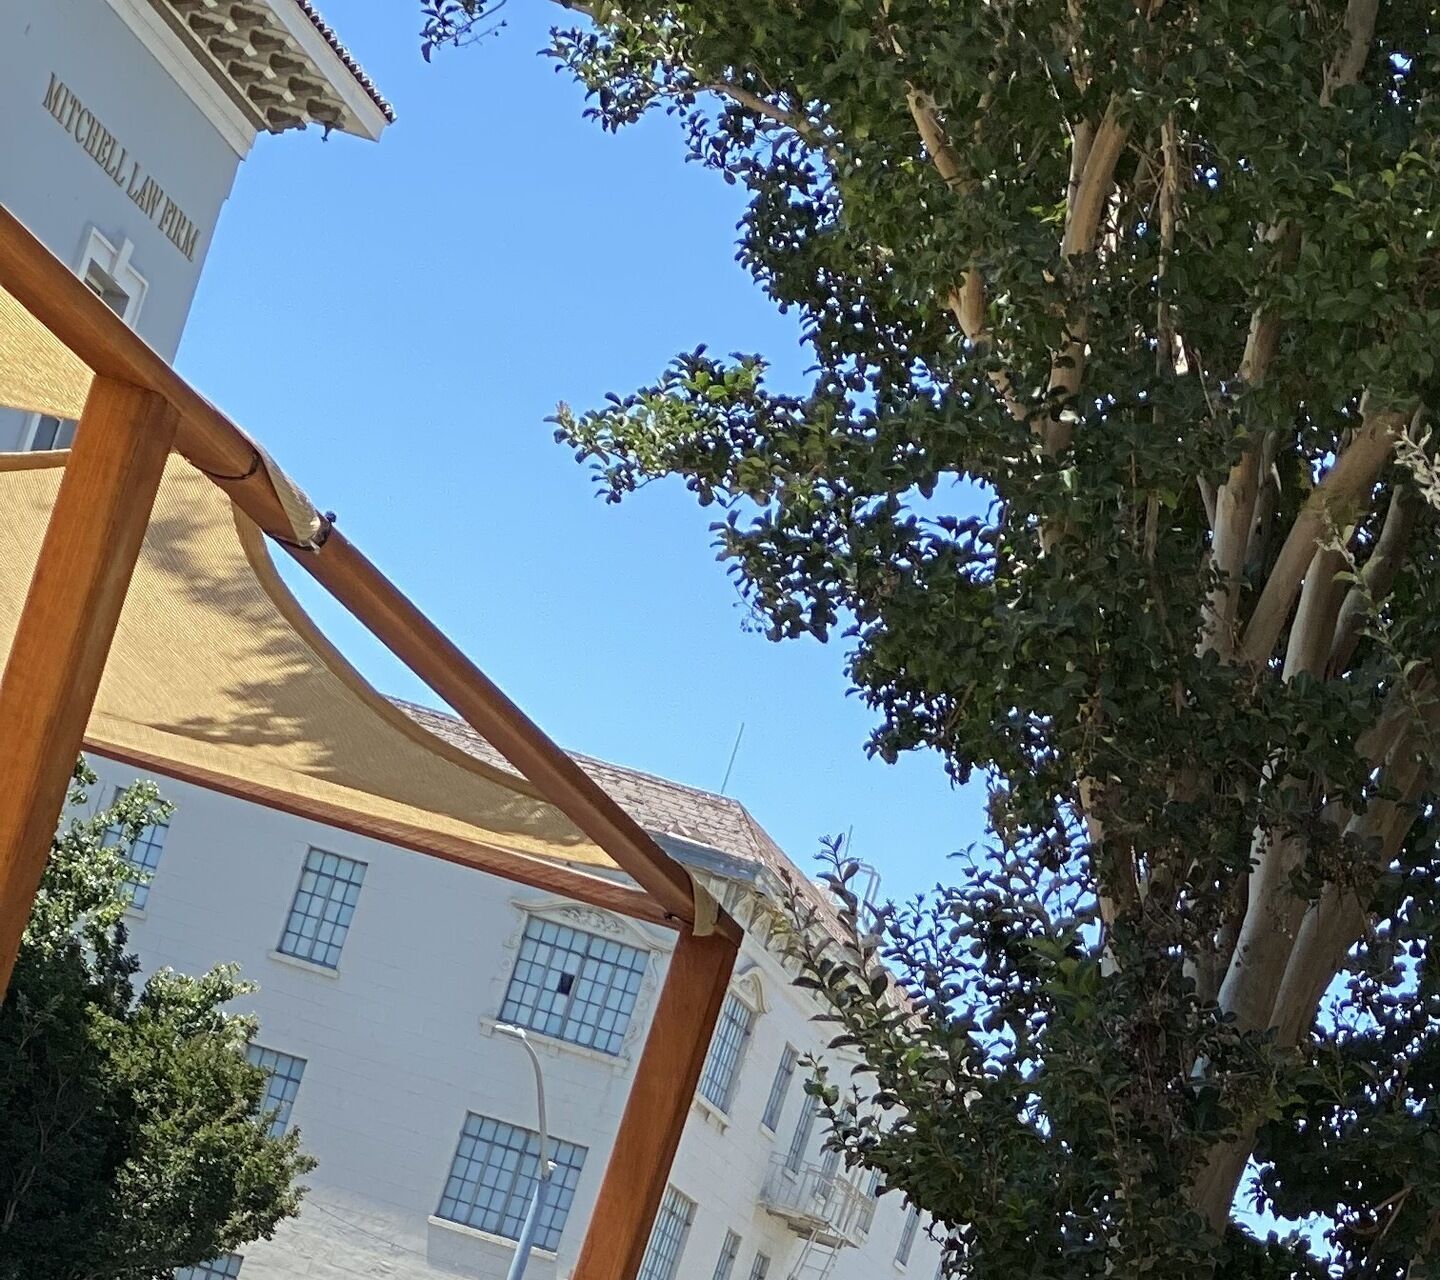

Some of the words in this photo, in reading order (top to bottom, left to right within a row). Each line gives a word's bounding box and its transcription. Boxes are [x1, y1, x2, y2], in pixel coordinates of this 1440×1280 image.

[42, 72, 128, 187] MITCHELL
[126, 161, 164, 219] LAW
[158, 196, 199, 262] FIRM
